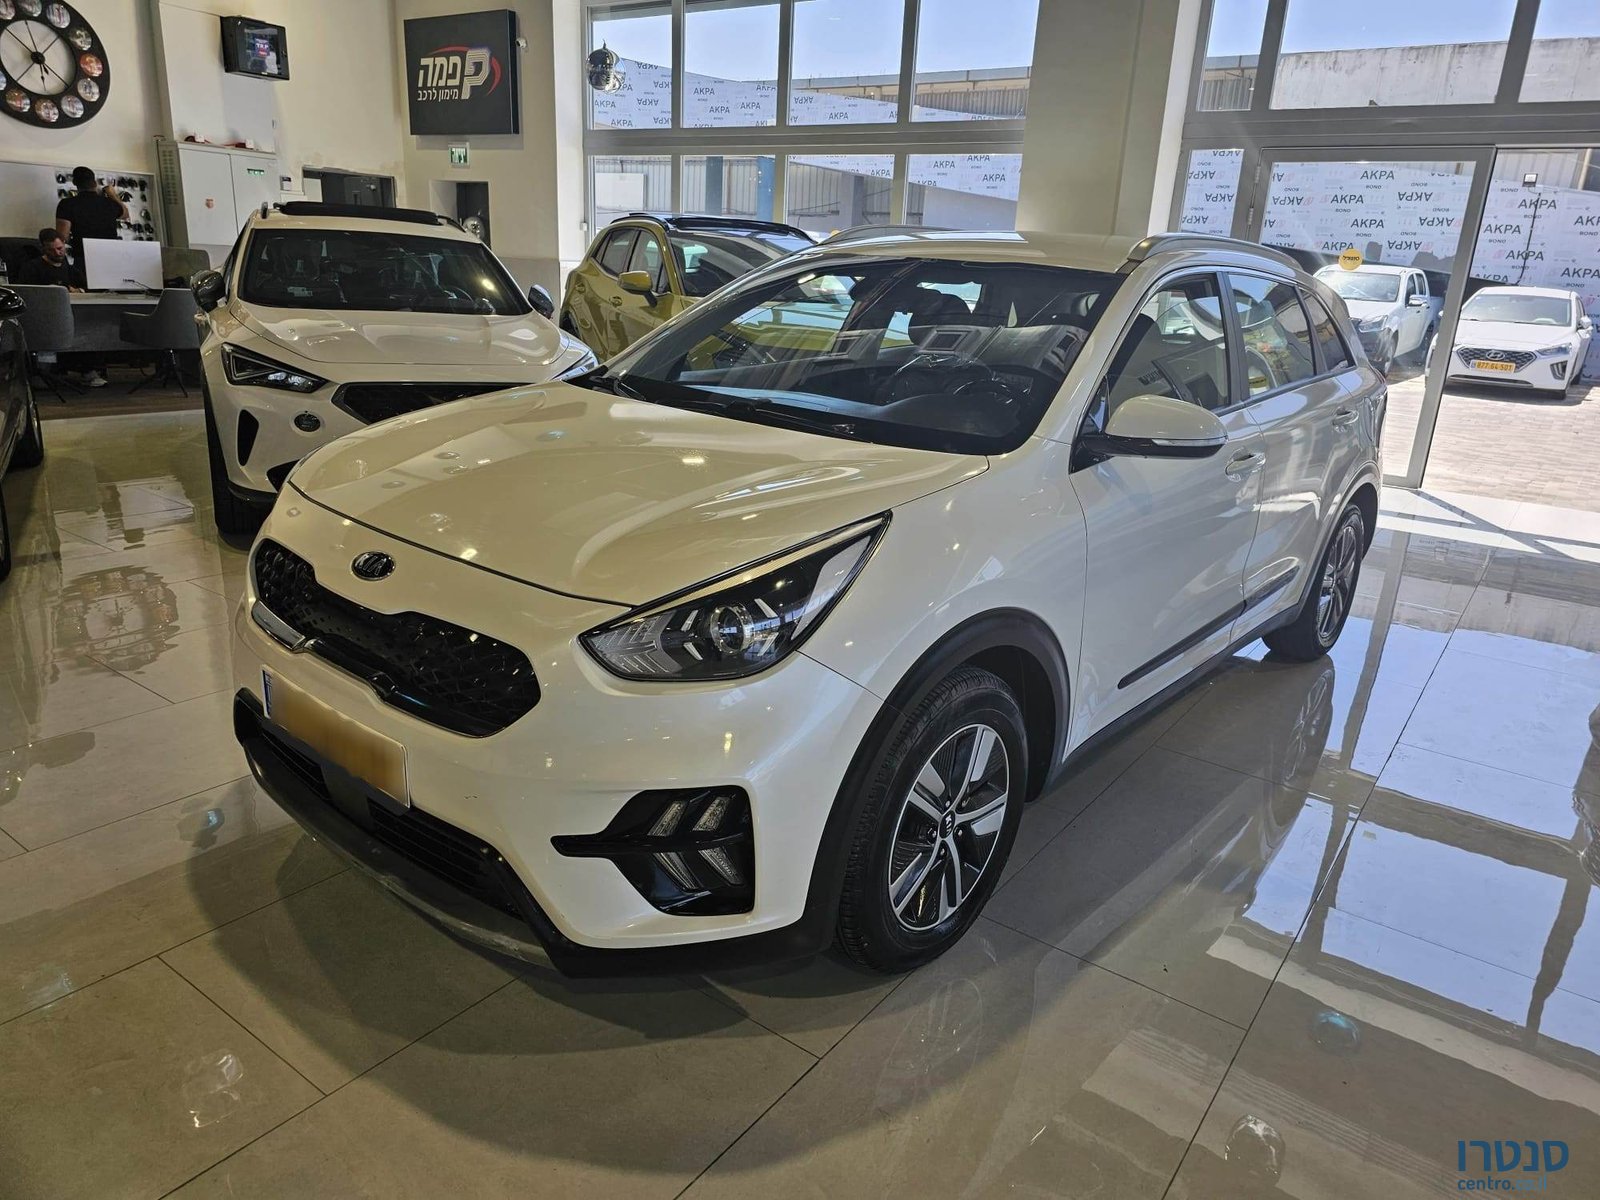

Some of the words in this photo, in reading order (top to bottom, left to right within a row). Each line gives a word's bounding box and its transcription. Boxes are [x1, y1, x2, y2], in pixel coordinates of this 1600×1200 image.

[417, 87, 437, 101] לרכב
[438, 88, 459, 102] מימון
[693, 87, 715, 96] AKPA
[593, 99, 616, 108] AKPA
[636, 97, 659, 106] AKPA
[740, 101, 761, 110] AKPA
[794, 96, 814, 104] AKPA
[708, 105, 730, 114] AKPA
[828, 111, 849, 120] AKPA
[610, 118, 633, 127] AKPA
[933, 160, 956, 169] AKPA
[982, 173, 1006, 182] AKPA
[1359, 170, 1395, 180] AKPA
[1204, 192, 1235, 203] AKPA
[1272, 195, 1304, 206] AKPA
[1330, 194, 1364, 205] AKPA
[1397, 191, 1433, 202] AKPA
[1517, 199, 1557, 210] AKPA
[1350, 218, 1385, 229] AKPA
[1418, 216, 1455, 227] AKPA
[1483, 223, 1521, 235] AKPA
[1321, 241, 1355, 251] AKPA
[1387, 240, 1423, 251] AKPA
[1505, 250, 1544, 261] AKPA
[1560, 267, 1600, 279] AKPA
